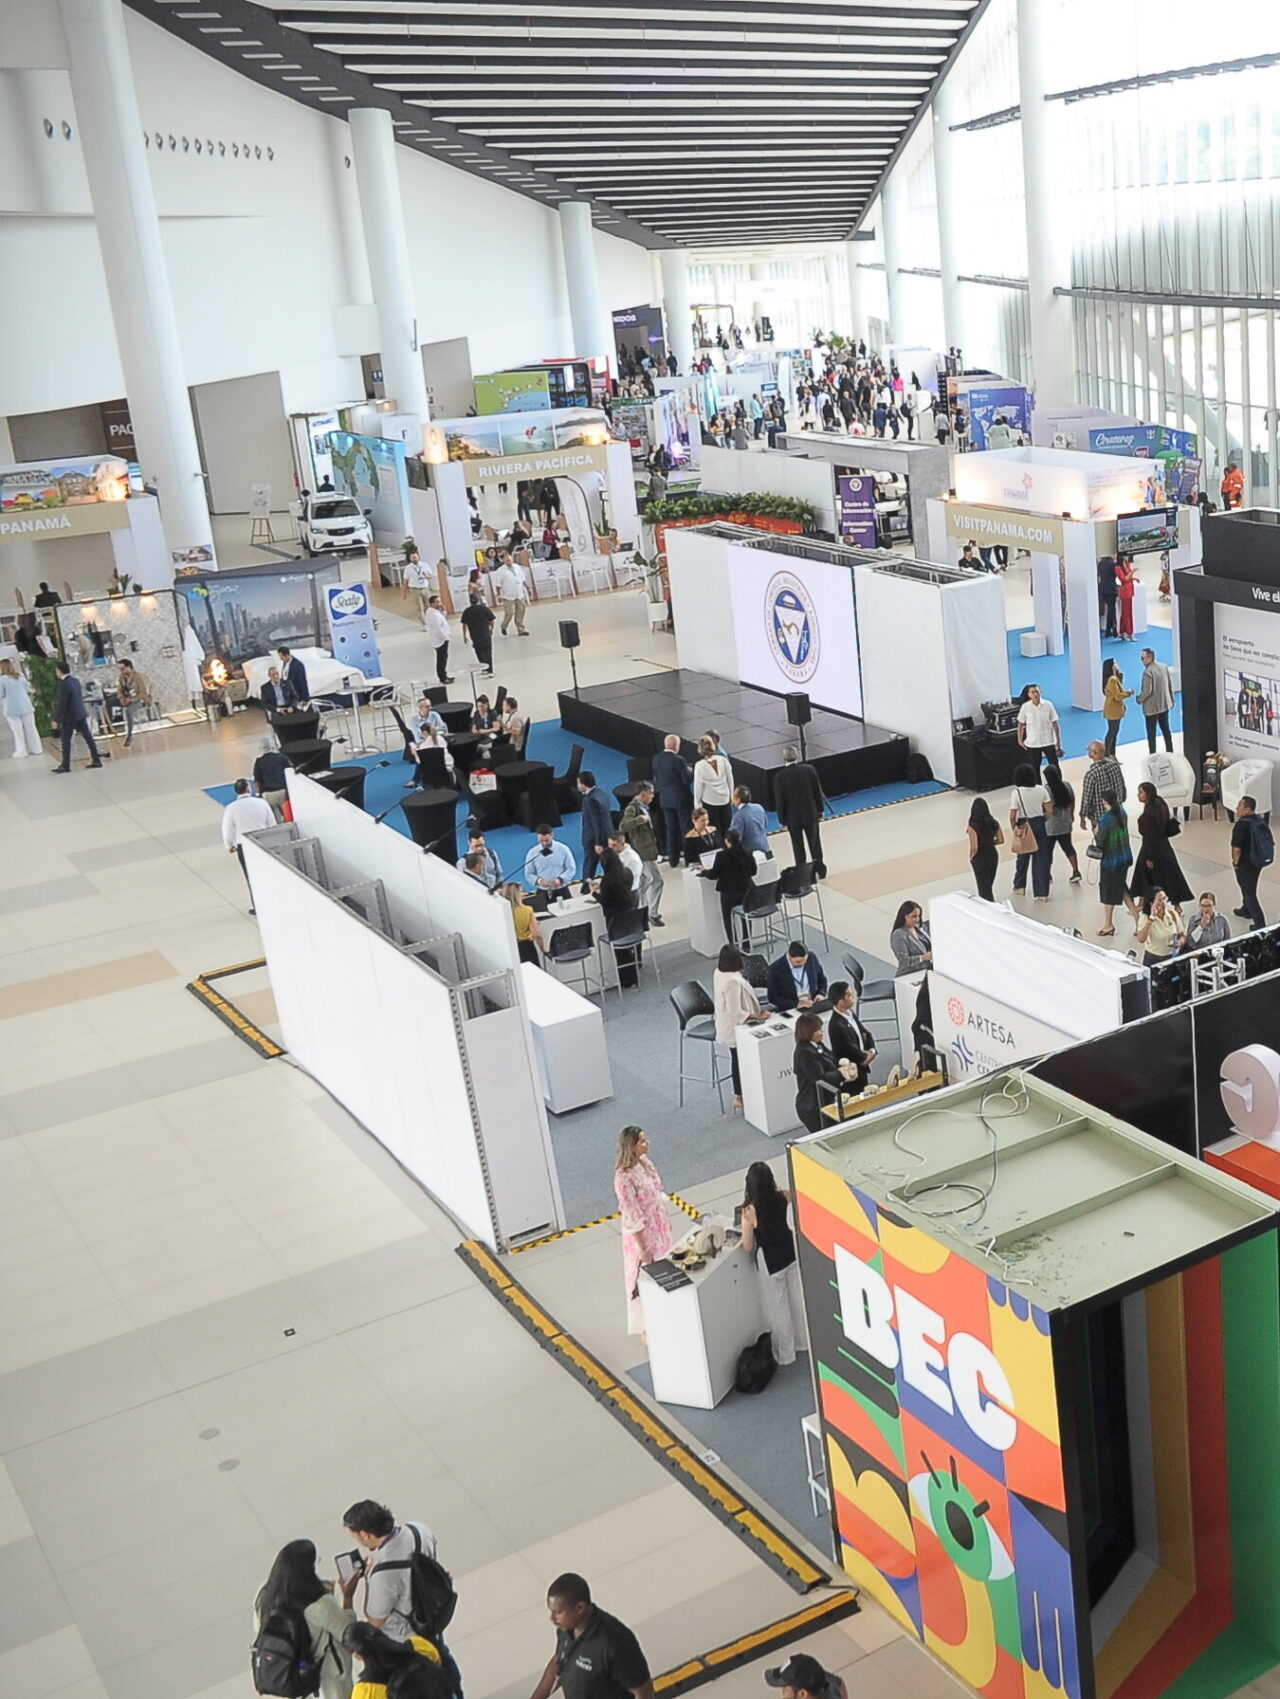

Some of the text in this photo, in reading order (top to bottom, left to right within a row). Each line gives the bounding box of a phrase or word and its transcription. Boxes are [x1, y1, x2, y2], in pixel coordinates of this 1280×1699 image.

[479, 462, 532, 477] RIVIERA
[1, 514, 71, 534] PANAMÁ
[953, 514, 1053, 543] VISITPANAMA.COM
[1252, 587, 1271, 601] Vive
[1272, 590, 1280, 603] el
[967, 1010, 1017, 1049] ARTESA
[833, 1242, 1017, 1451] BEC
